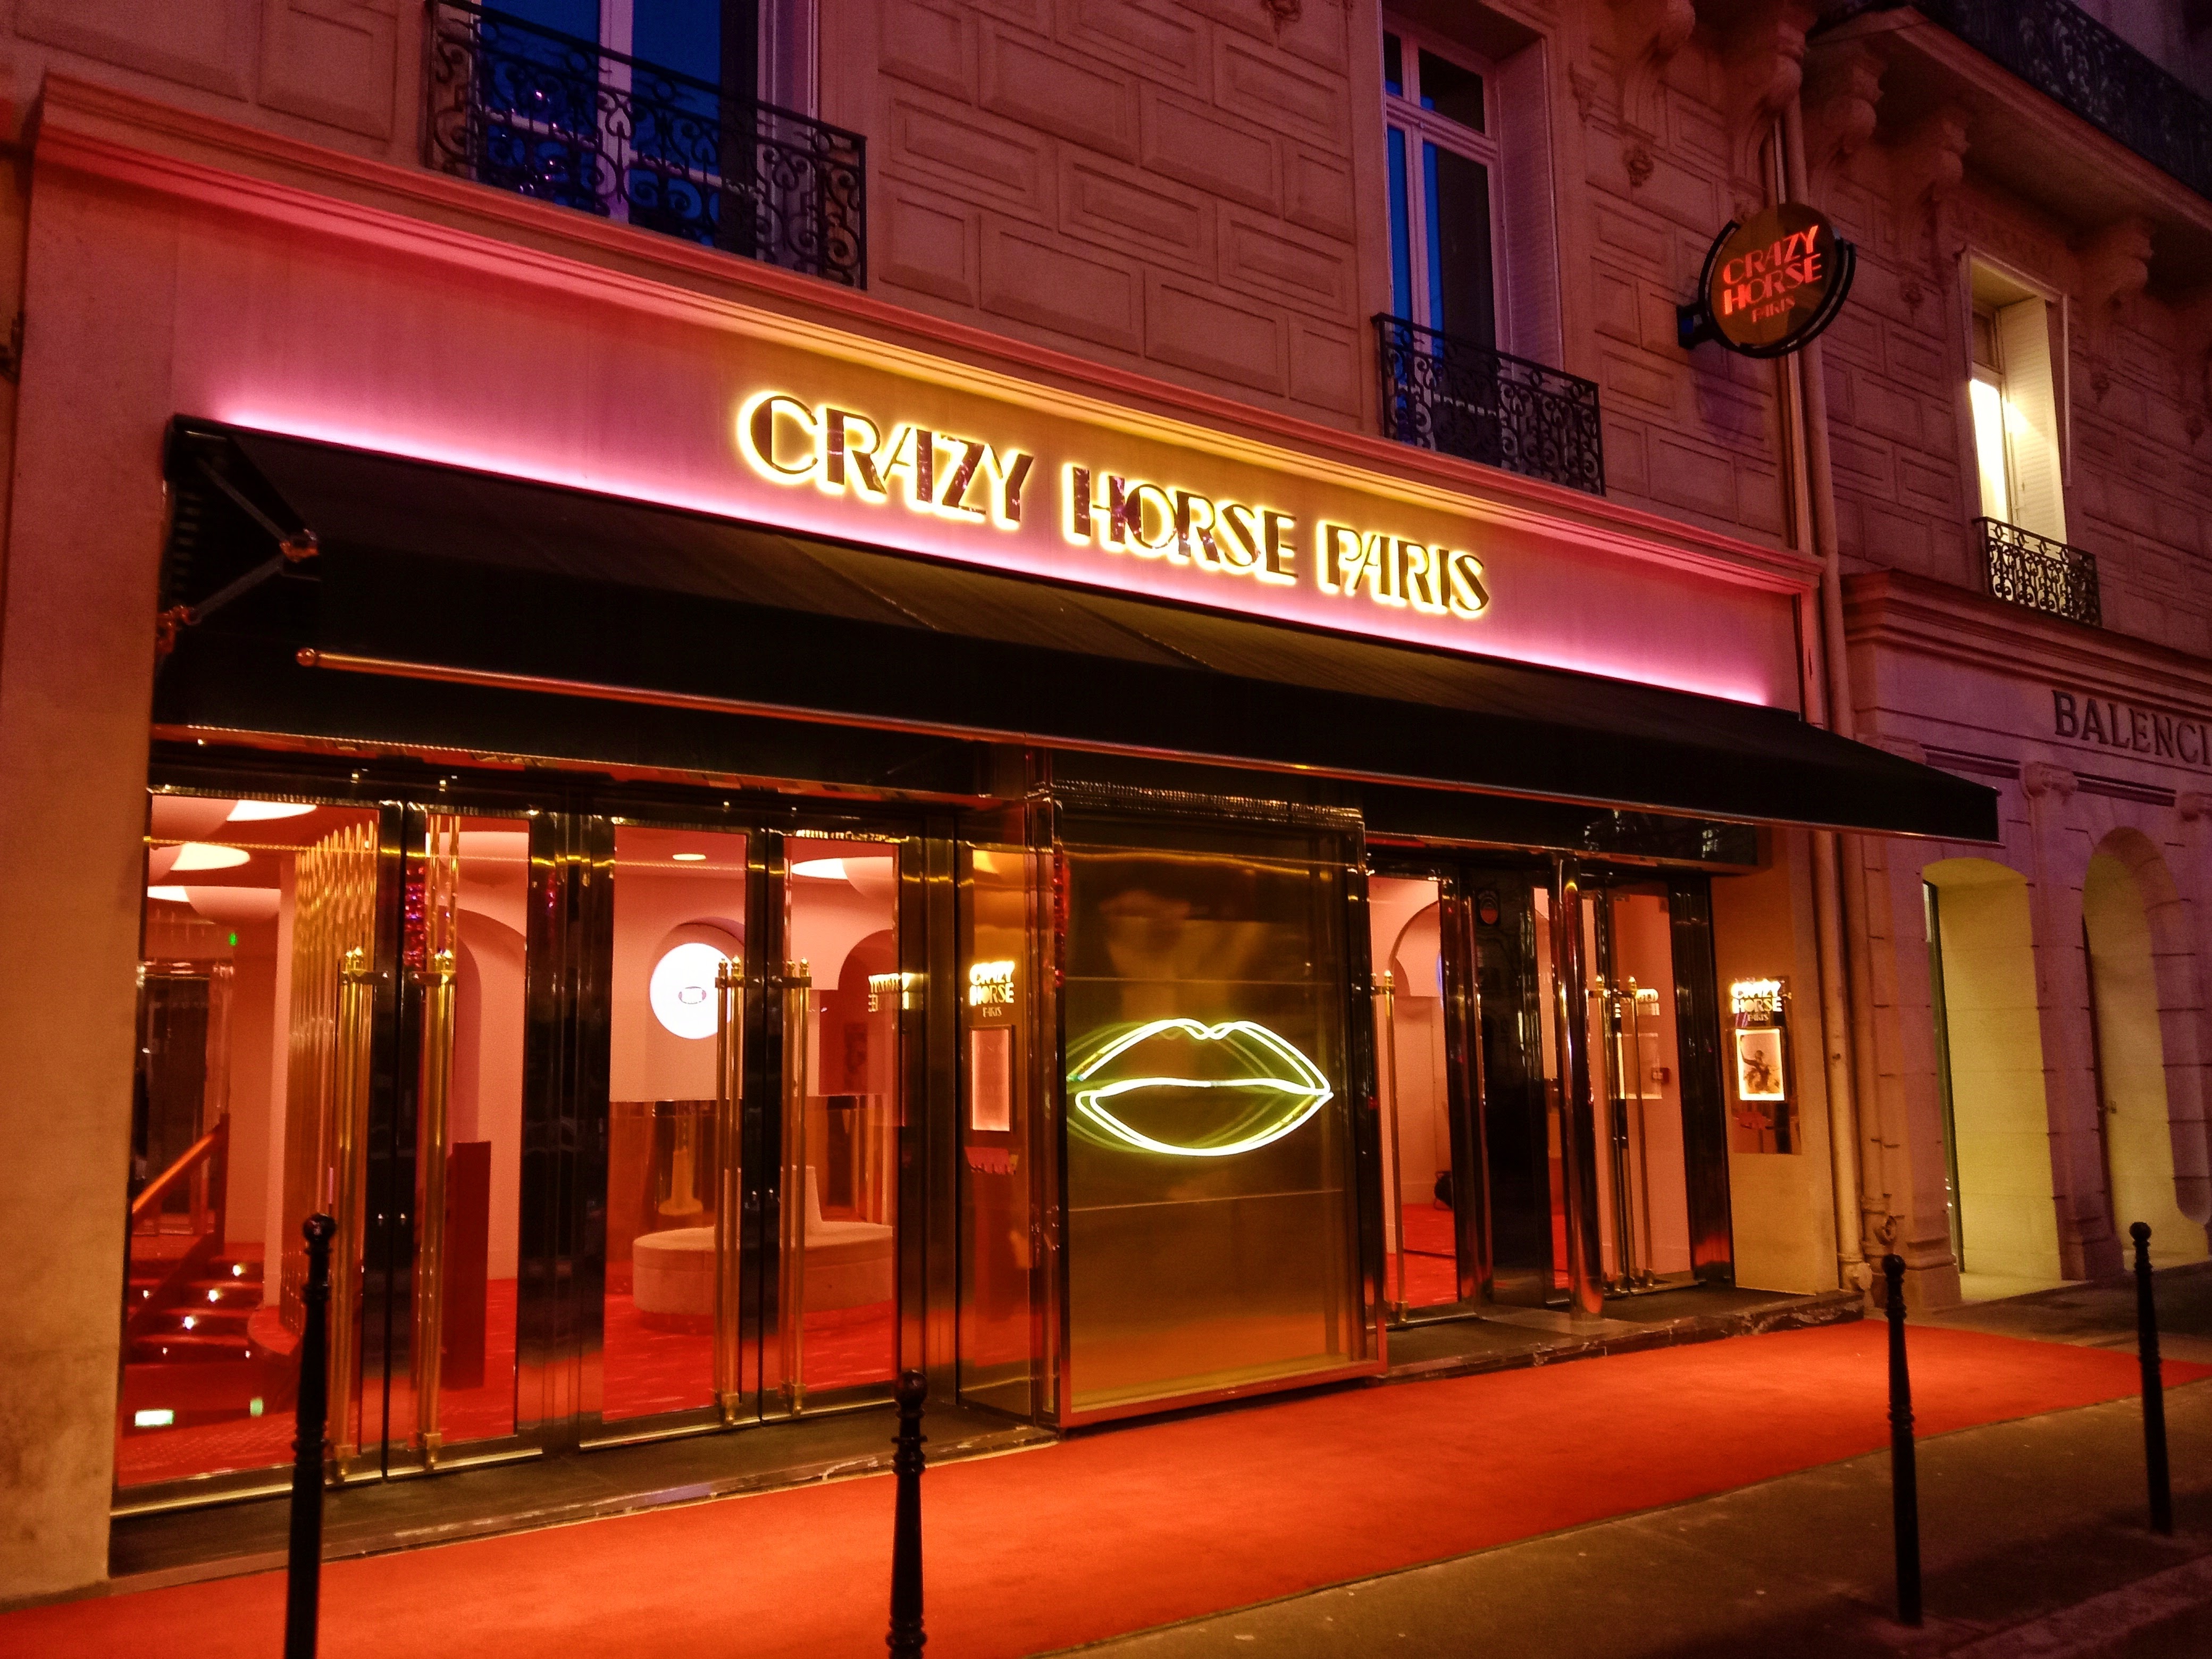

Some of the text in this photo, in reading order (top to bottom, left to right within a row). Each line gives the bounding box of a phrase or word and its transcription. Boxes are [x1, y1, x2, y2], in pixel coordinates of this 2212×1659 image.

[1723, 224, 1819, 284] CRAZY
[1723, 253, 1822, 315] HORSE
[1752, 296, 1796, 323] PARIS
[749, 395, 1489, 613] CRAZY HORSE PARIS
[2051, 689, 2211, 766] BALENCI
[969, 961, 1015, 985] CRAZY
[969, 982, 1015, 1006] HORSE
[1732, 996, 1782, 1014] HORSE
